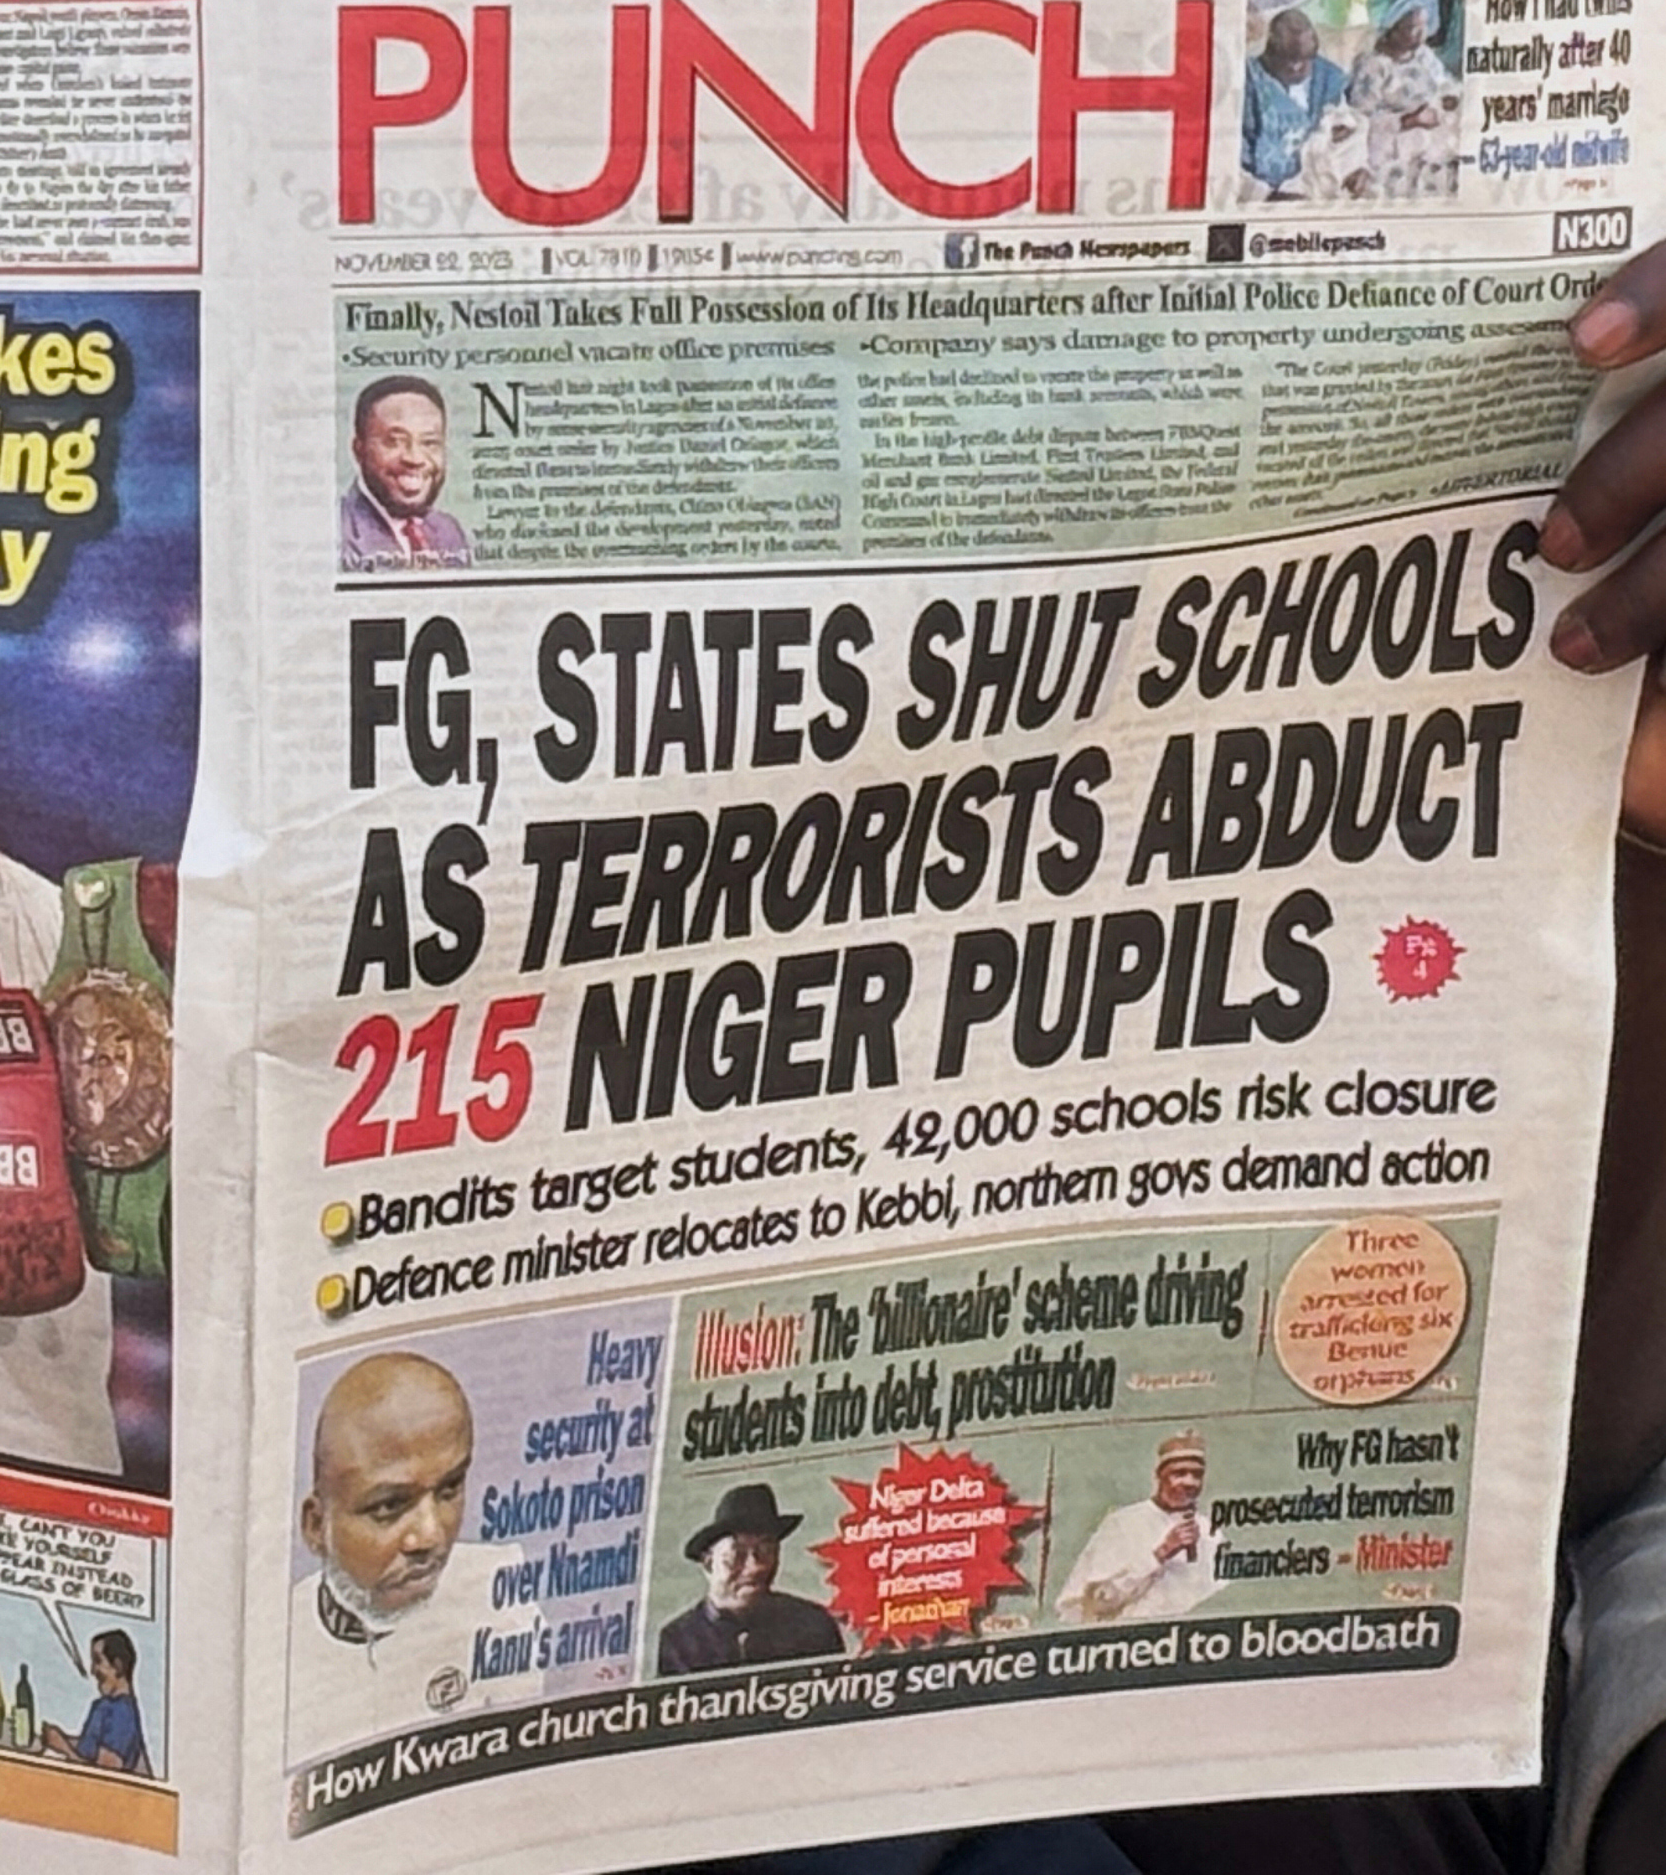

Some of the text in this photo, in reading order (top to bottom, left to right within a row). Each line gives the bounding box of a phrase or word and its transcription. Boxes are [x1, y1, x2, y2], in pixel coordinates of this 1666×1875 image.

[1466, 29, 1630, 79] naturally after 40
[1482, 79, 1629, 132] years' marriage
[983, 238, 1192, 262] The Punch Newspapers
[1558, 213, 1627, 250] N300
[346, 272, 1545, 339] Finally, Nestoil Takes Full Possession of Its Headquarters after Initial Police Defiance of Court
[350, 337, 835, 373] Security personnel vacate office premises
[870, 321, 1466, 358] Company says damage to property undergoing
[349, 520, 1538, 825] FG, STATES SHUT SCHOOLS
[336, 699, 1525, 997] AS TERRORISTS ABDUCT
[323, 887, 1335, 1166] 215 NIGER PUPILS
[357, 1070, 1499, 1239] Bandits target students, 42,000 schools risk closure
[351, 1139, 1490, 1313] Defence minister relocates to Kebbi, northern govs demand action
[1346, 1228, 1420, 1253] Three
[1331, 1258, 1426, 1283] women
[692, 1252, 1249, 1381] Illusion: The 'billionaire' scheme driving
[1300, 1281, 1450, 1313] arrested for
[1419, 1308, 1453, 1331] six
[586, 1330, 664, 1387] Heavy
[1328, 1340, 1409, 1363] Benue
[682, 1342, 1117, 1462] students into debt, prostitution
[526, 1399, 654, 1466] security at
[1297, 1423, 1461, 1475] Why FG hasn't
[480, 1465, 644, 1541] Sokoto prison
[870, 1475, 985, 1515] Niger Delta
[1210, 1479, 1454, 1532] prosecuted terrorism
[844, 1507, 1006, 1544] suffered because
[492, 1527, 640, 1610] over Nnamdi
[868, 1532, 976, 1574] of personal
[1214, 1532, 1452, 1581] financiers Minister
[0, 1568, 56, 1593] GLASS
[883, 1592, 970, 1631] Jonathan
[470, 1601, 634, 1684] Kanu's arrival
[306, 1606, 1441, 1812] How Kwara church thanksgiving service turned to bloodbath
